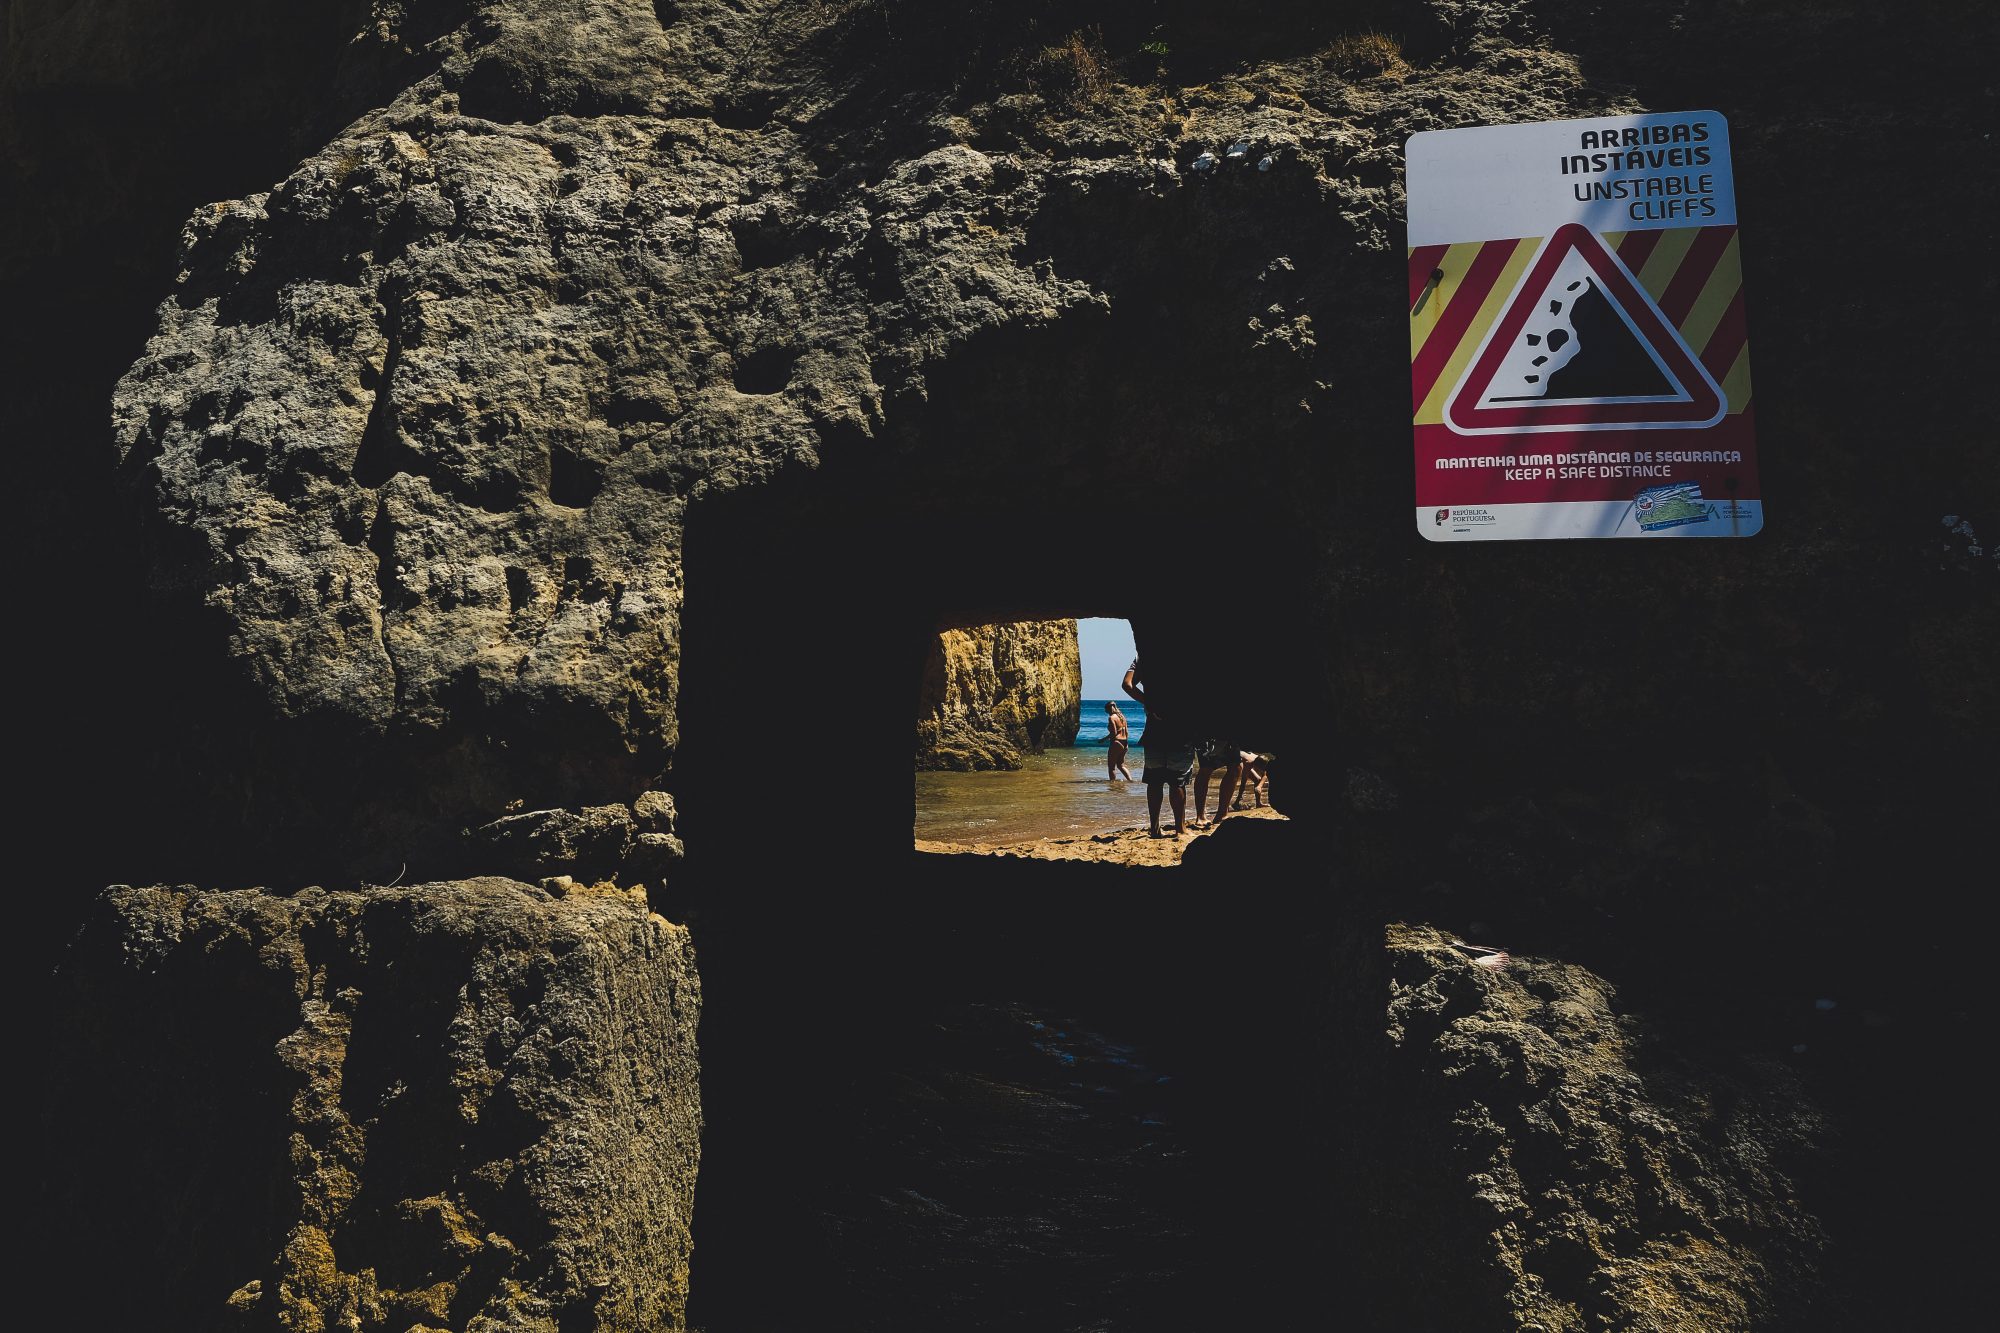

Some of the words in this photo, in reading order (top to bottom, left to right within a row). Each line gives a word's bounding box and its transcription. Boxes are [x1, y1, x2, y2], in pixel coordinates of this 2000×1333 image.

[1581, 122, 1709, 149] ARRIBAS
[1561, 146, 1711, 174] INSTÁVEIS
[1574, 174, 1714, 201] UNSTABLE
[1629, 197, 1716, 221] CLIFFS
[1435, 455, 1516, 469] MANTENHA
[1519, 454, 1553, 466] UMA
[1556, 451, 1631, 465] DISTÂNCIA
[1634, 451, 1653, 463] DE
[1656, 450, 1742, 465] SEGURANÇA
[1505, 468, 1542, 481] KEEP
[1545, 467, 1556, 480] A
[1559, 466, 1597, 479] SAFE
[1600, 465, 1672, 478] DISTANCE
